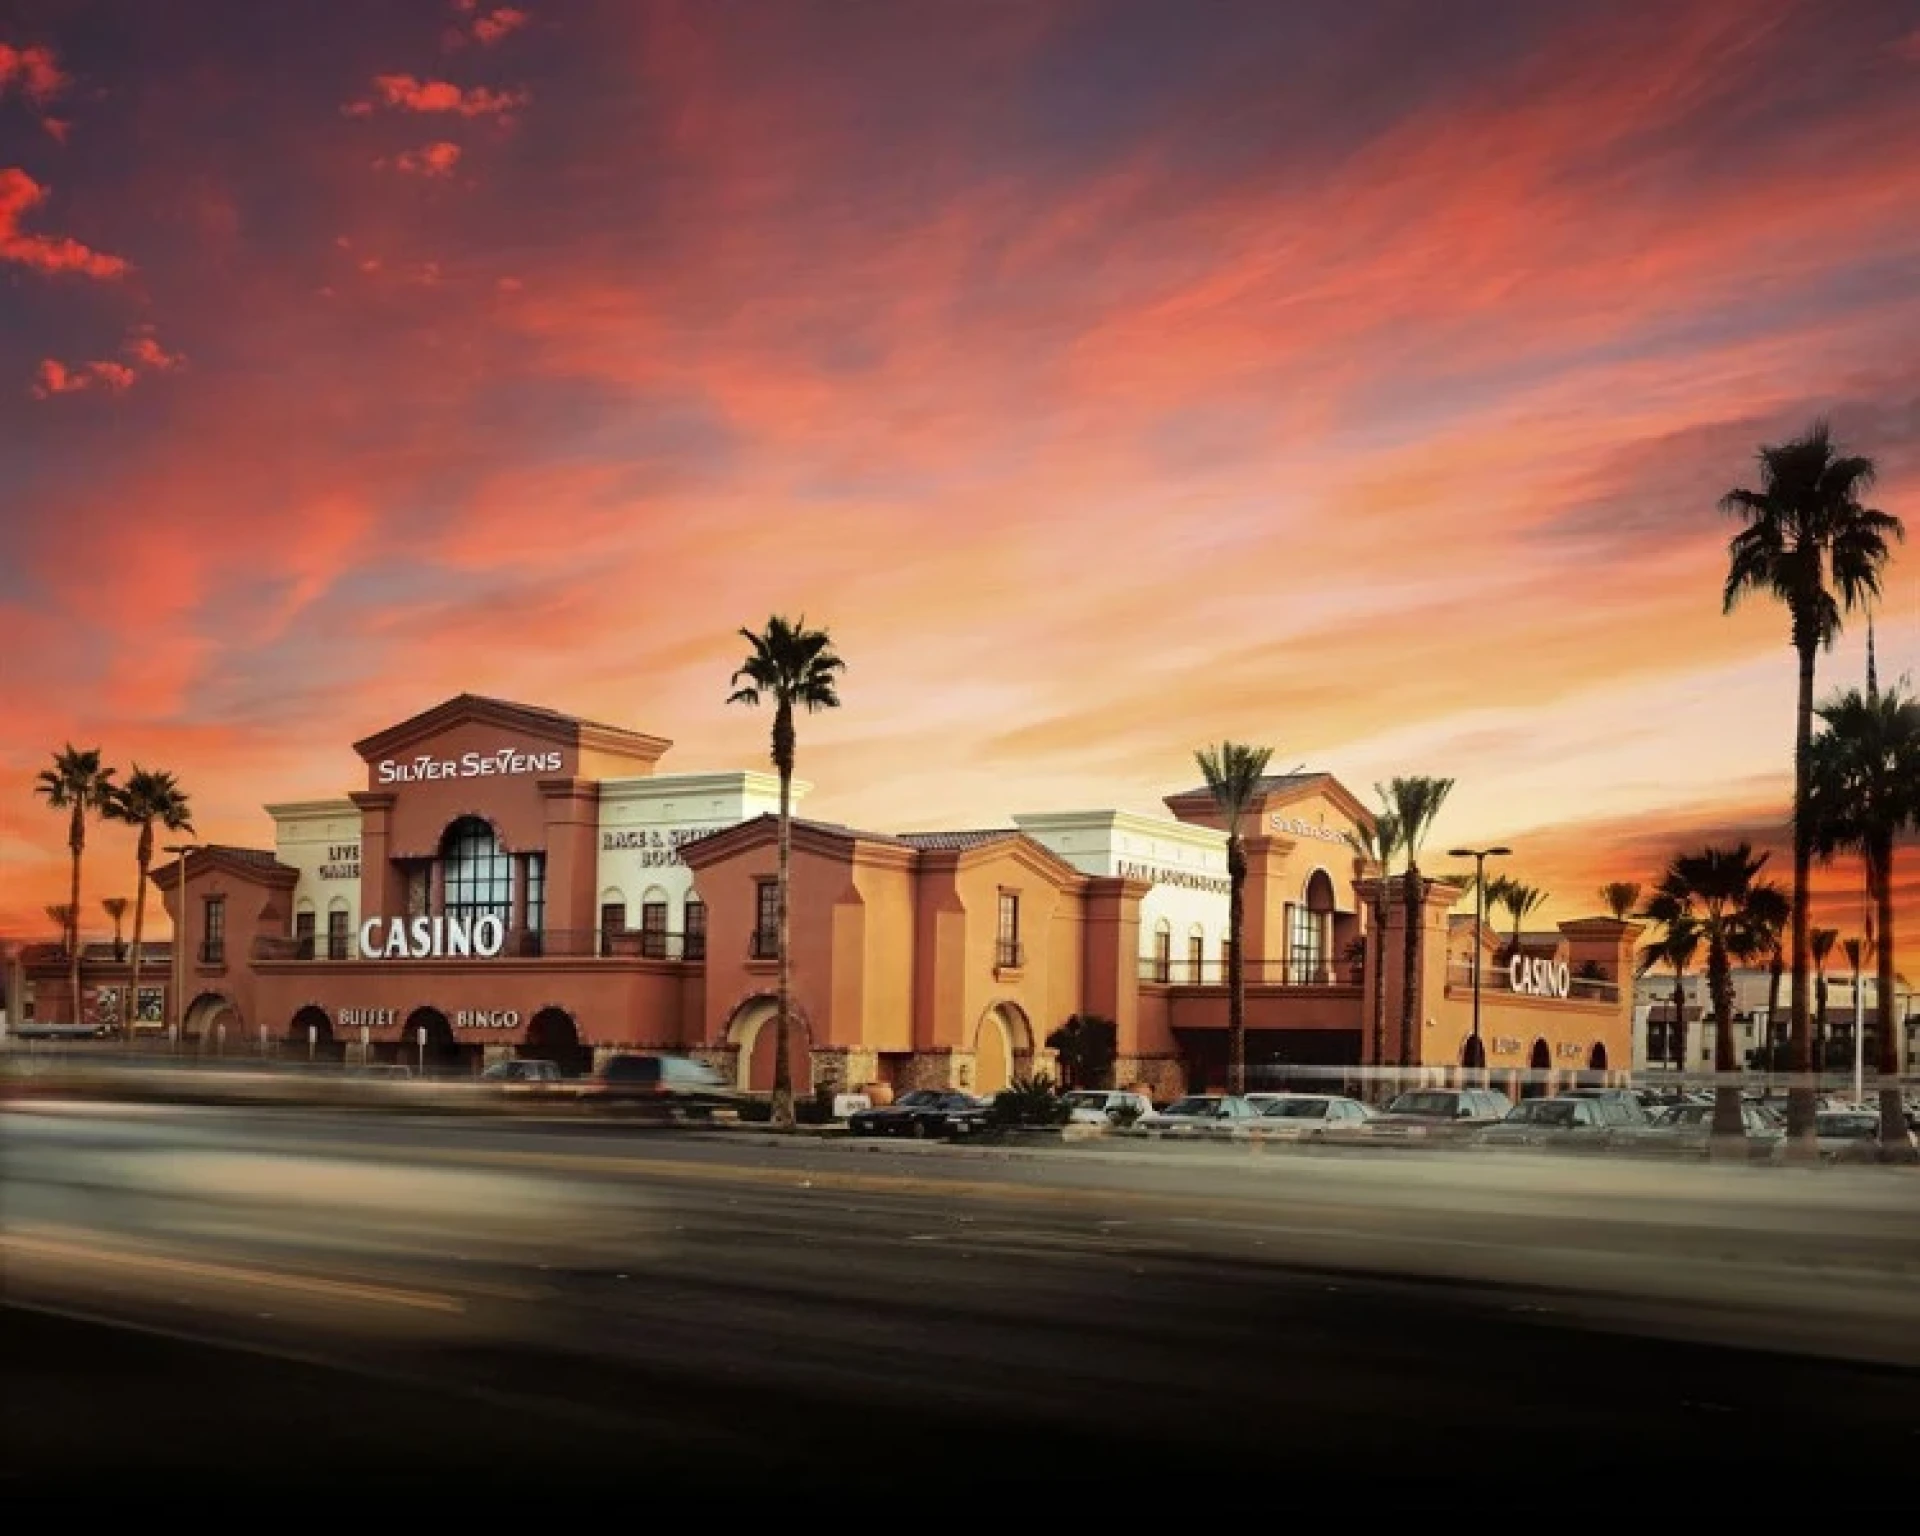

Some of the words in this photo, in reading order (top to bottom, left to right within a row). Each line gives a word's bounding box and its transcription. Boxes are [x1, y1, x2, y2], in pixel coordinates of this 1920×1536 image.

[360, 913, 504, 958] CASINO
[1510, 954, 1570, 999] CASINO
[337, 1008, 396, 1025] BUFFET
[457, 1010, 519, 1028] BINGO
